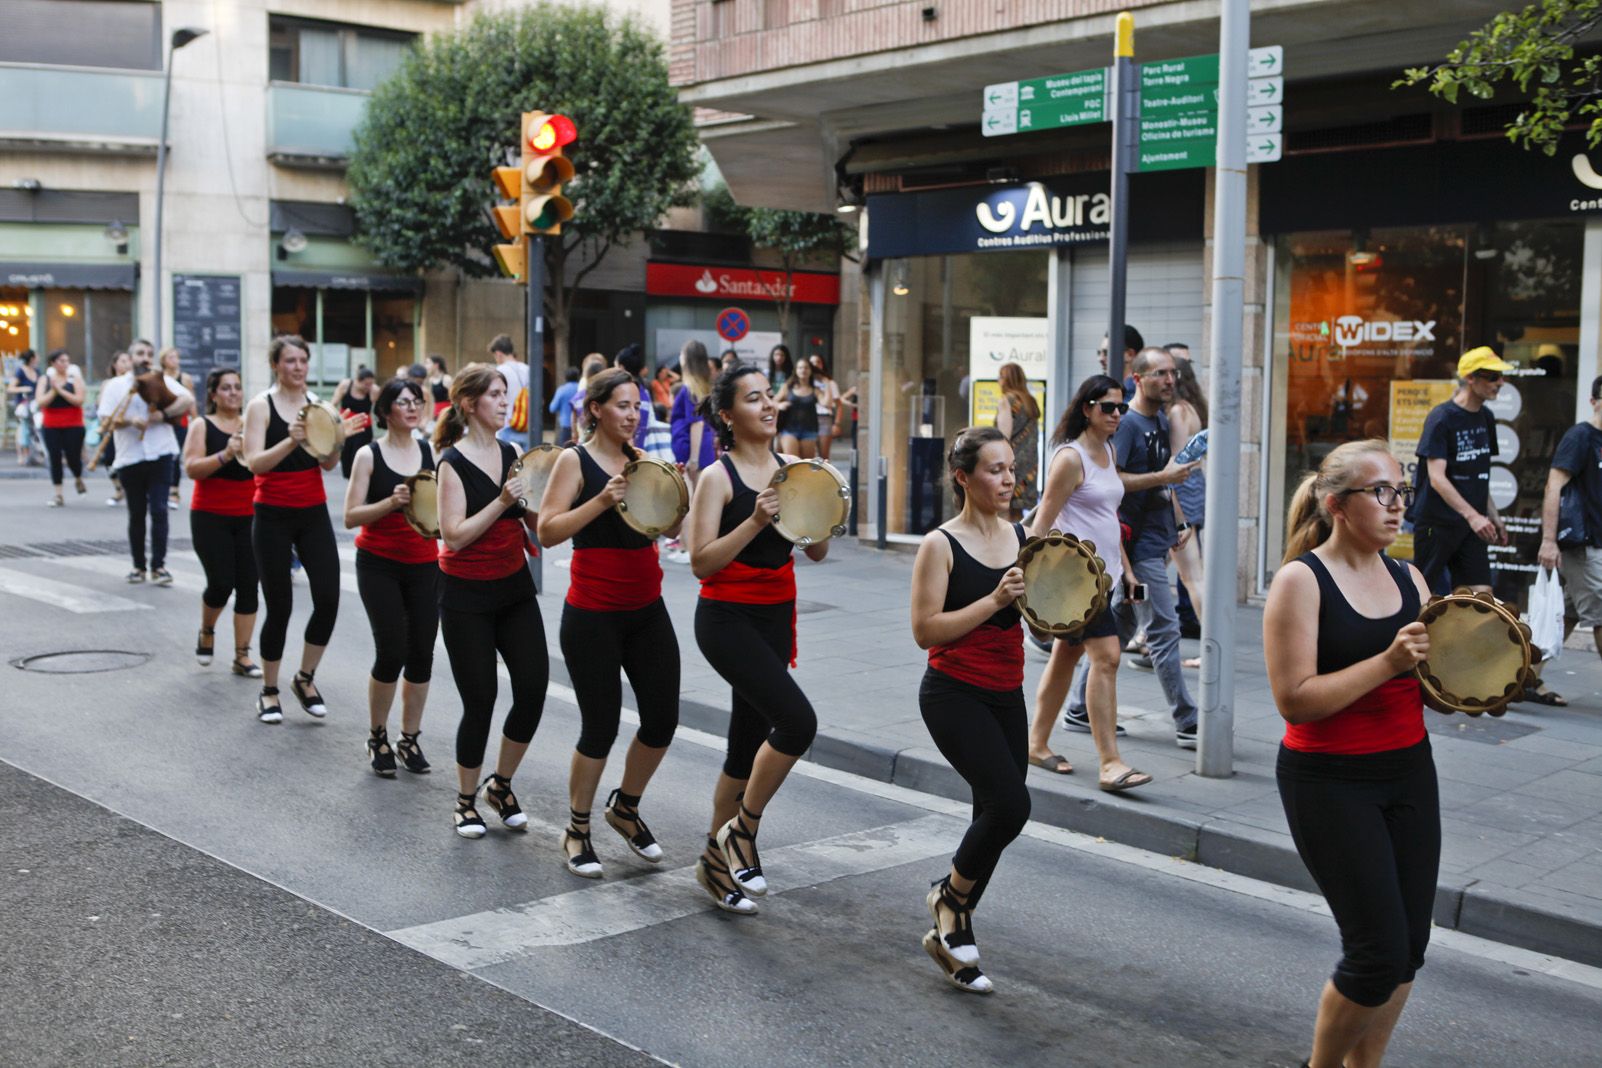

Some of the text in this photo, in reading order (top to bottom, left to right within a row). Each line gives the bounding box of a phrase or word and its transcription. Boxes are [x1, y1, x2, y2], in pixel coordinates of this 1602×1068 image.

[1143, 63, 1185, 75] Parc Rural
[1045, 80, 1070, 89] Museu
[1071, 76, 1082, 84] del
[1143, 75, 1189, 86] Torre Negra
[1050, 85, 1103, 98] Contemporani
[1143, 94, 1204, 108] Teatre-Auditori
[1079, 111, 1101, 120] Millet
[1141, 117, 1207, 130] Monestir-Museu
[1141, 128, 1214, 141] Oficina de turisme
[1141, 152, 1188, 164] Ajuntament
[1020, 181, 1111, 230] Aura
[1569, 198, 1602, 211] Cent
[977, 231, 1111, 248] Centres Auditius Professiona
[719, 274, 797, 297] Santander
[1335, 315, 1436, 346] WIDEX
[1008, 347, 1046, 361] Aural
